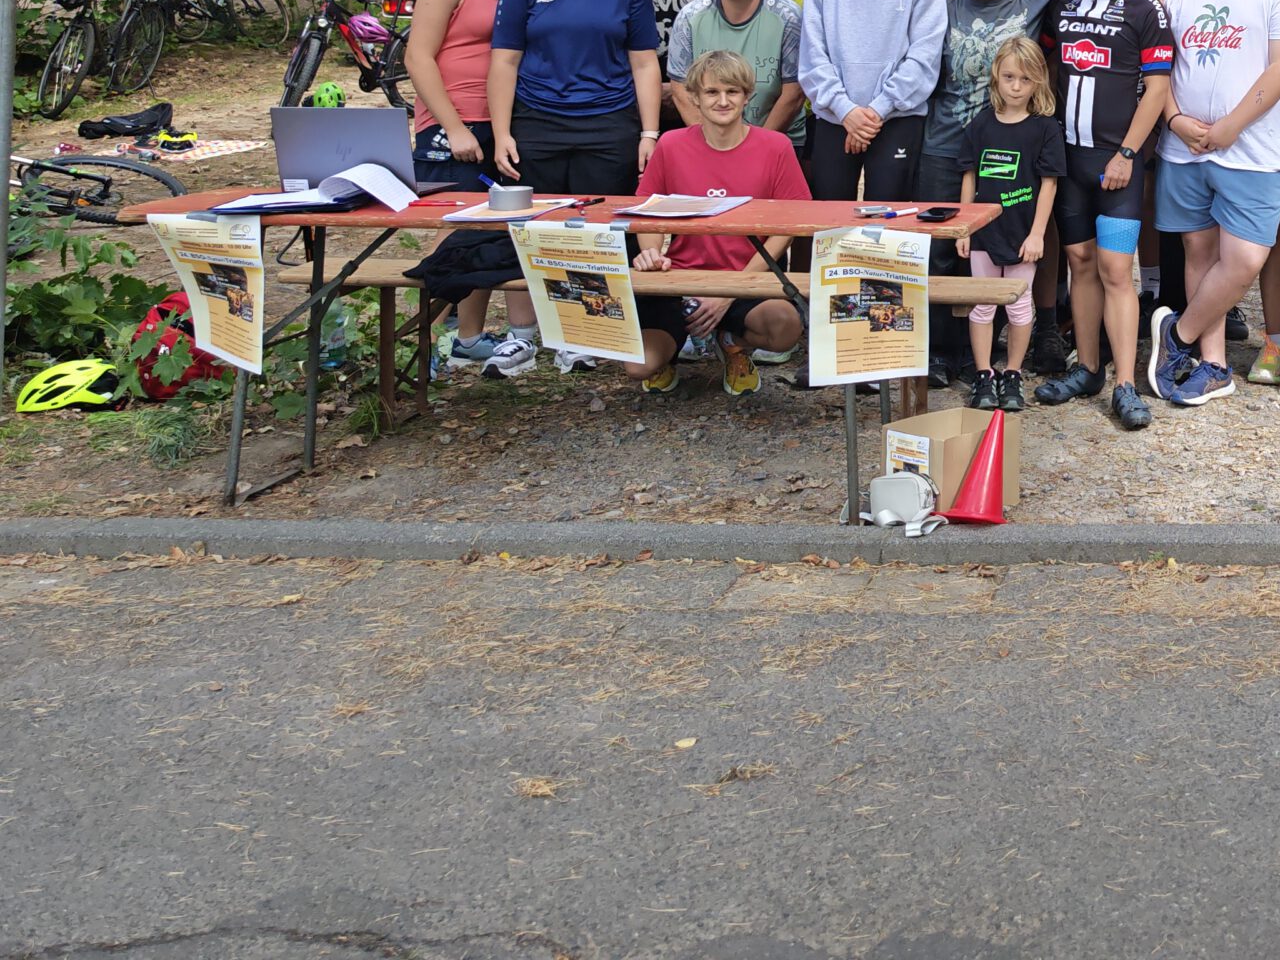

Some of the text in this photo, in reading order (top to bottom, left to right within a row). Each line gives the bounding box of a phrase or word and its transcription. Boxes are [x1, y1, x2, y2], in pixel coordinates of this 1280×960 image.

[1069, 21, 1122, 37] GIANT
[1065, 46, 1105, 64] Alpecin
[842, 268, 919, 283] BSO-Natur-Triathlon
